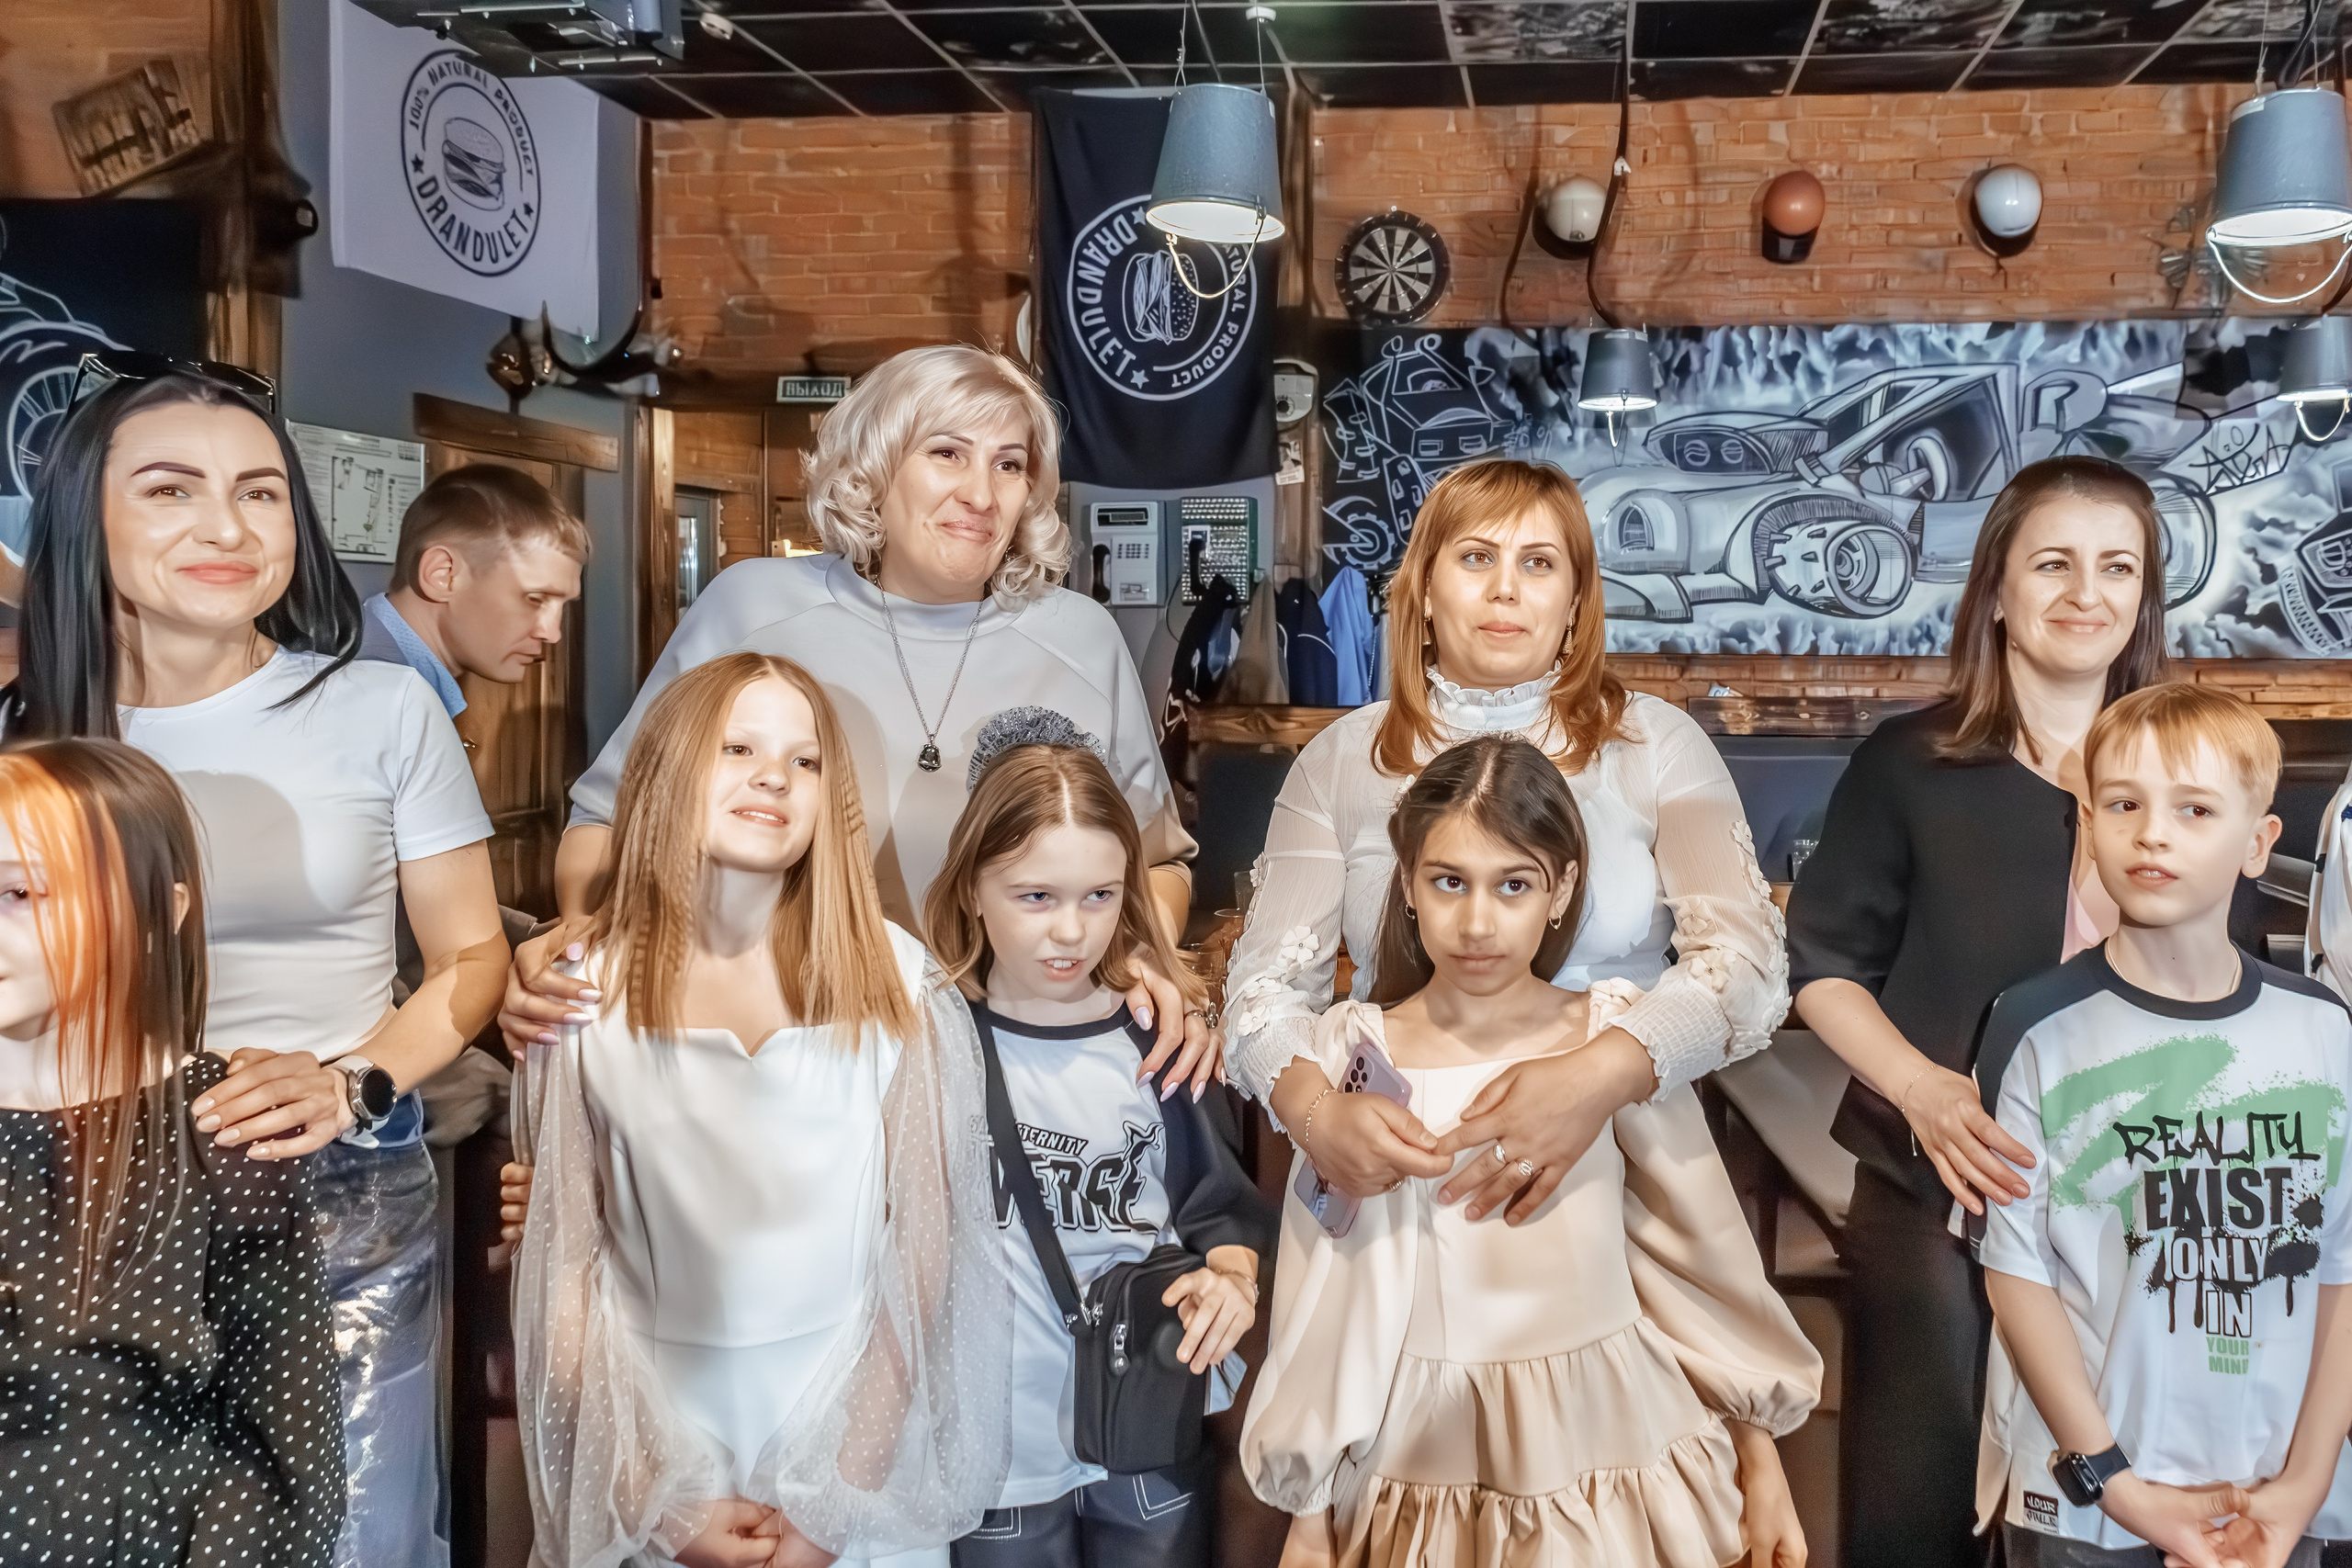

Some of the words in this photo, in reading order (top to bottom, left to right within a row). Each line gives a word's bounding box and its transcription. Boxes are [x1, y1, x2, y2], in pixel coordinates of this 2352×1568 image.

[427, 62, 488, 89] NATURAL
[494, 88, 534, 175] PRODUCT
[416, 175, 528, 264] DRANDULET
[1077, 214, 1138, 377] DRANDULET
[1222, 243, 1247, 312] ATURAL
[1171, 321, 1239, 388] PRODUCT
[1016, 1123, 1087, 1155] TERNITY
[2113, 1111, 2321, 1167] REALITY
[2143, 1167, 2291, 1231] EXIST
[2171, 1235, 2268, 1282] ONLY
[2206, 1290, 2252, 1337] IN
[2206, 1337, 2249, 1355] YOUR
